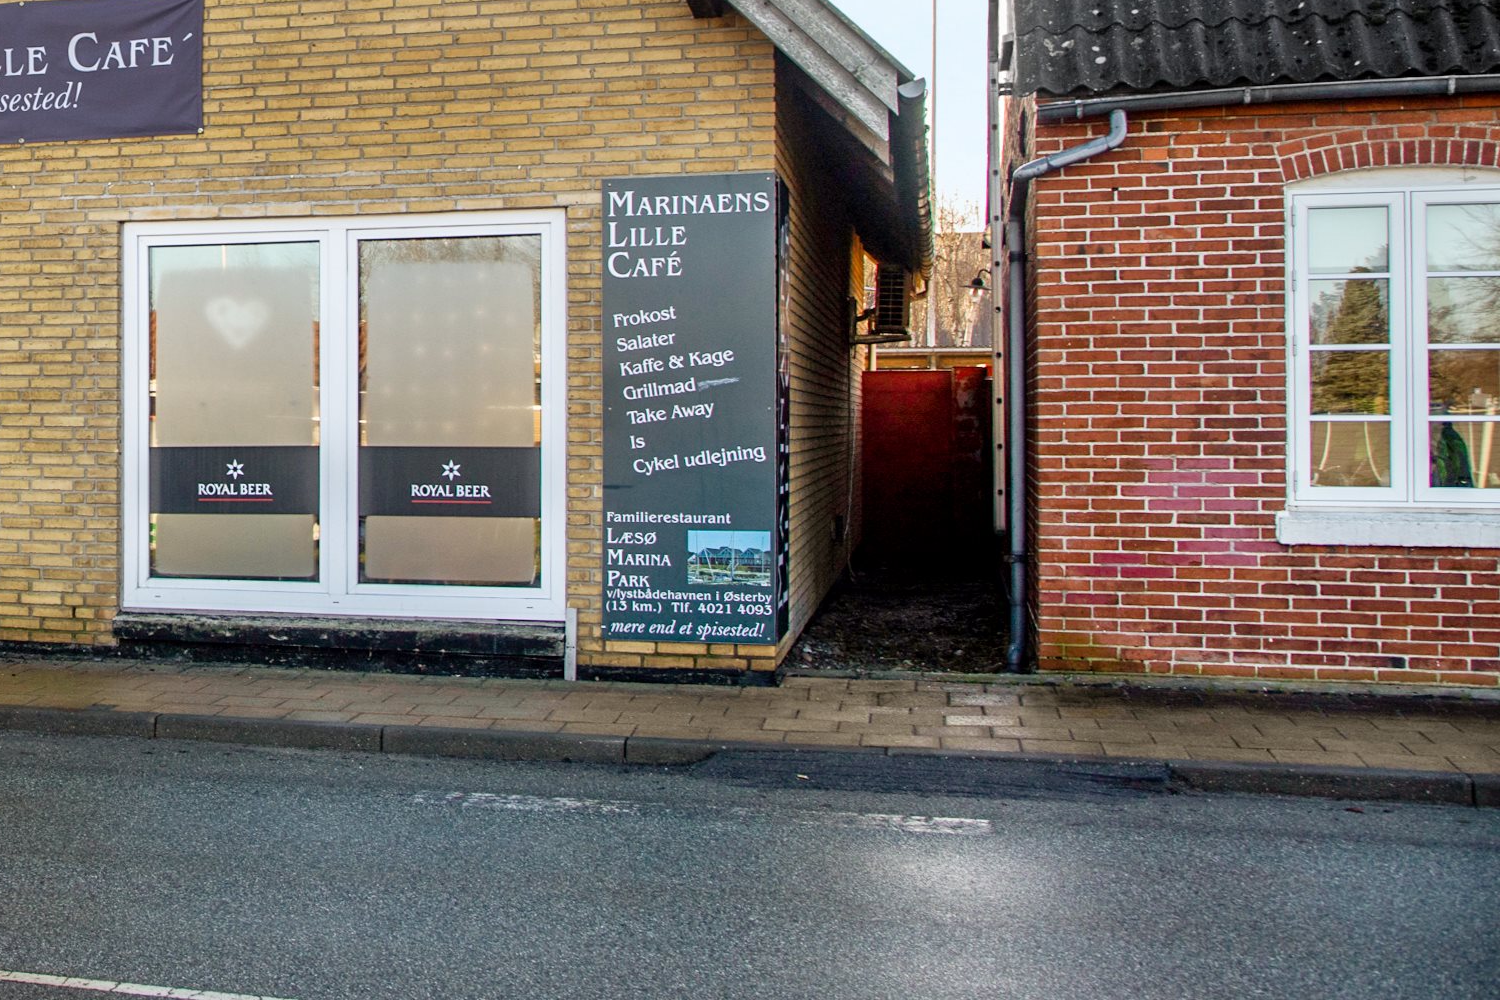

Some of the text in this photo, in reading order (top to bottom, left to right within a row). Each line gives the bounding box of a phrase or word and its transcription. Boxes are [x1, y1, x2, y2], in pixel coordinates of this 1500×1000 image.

[608, 190, 770, 217] MARINAENS
[608, 221, 687, 248] LILLE
[607, 251, 683, 278] CAFÉ
[613, 305, 676, 328] Frokost
[616, 332, 676, 352] Salater
[620, 349, 734, 376] Kaffe & Kage
[623, 377, 696, 400] Grillmad
[626, 402, 714, 424] Take Away
[629, 435, 646, 449] Is
[633, 445, 767, 476] Cykel udlejning
[198, 483, 273, 496] ROYAL BEER
[411, 484, 491, 498] ROYAL BEER
[606, 511, 731, 524] Familierestaurant
[606, 528, 657, 545] LÆSØ
[607, 549, 671, 566] MARINA
[607, 570, 650, 587] PARK
[606, 586, 712, 601] v/lystbådehavnen
[723, 590, 772, 604] Østerby
[605, 600, 772, 616] (13 km.) Tlf. 4021 4093
[611, 621, 645, 633] mere
[649, 619, 676, 634] end
[679, 622, 693, 635] et
[695, 621, 765, 640] spisested!
